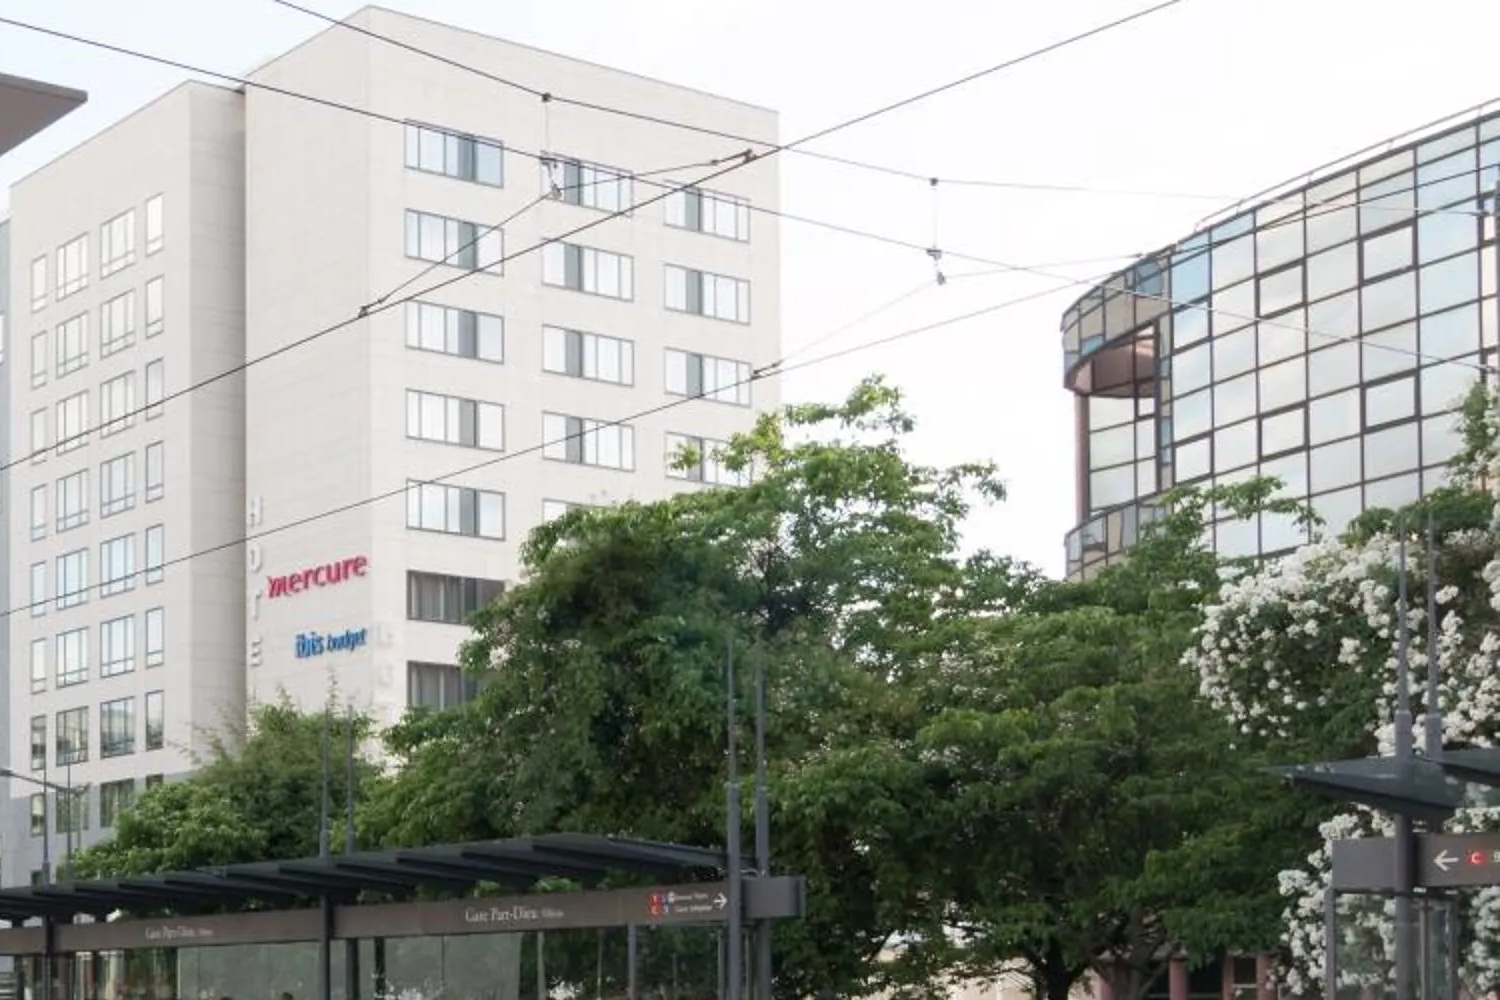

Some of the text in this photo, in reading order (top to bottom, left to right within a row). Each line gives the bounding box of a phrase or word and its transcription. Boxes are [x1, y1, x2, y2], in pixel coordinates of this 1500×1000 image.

[267, 554, 368, 598] mercure
[295, 627, 367, 658] ibis budget
